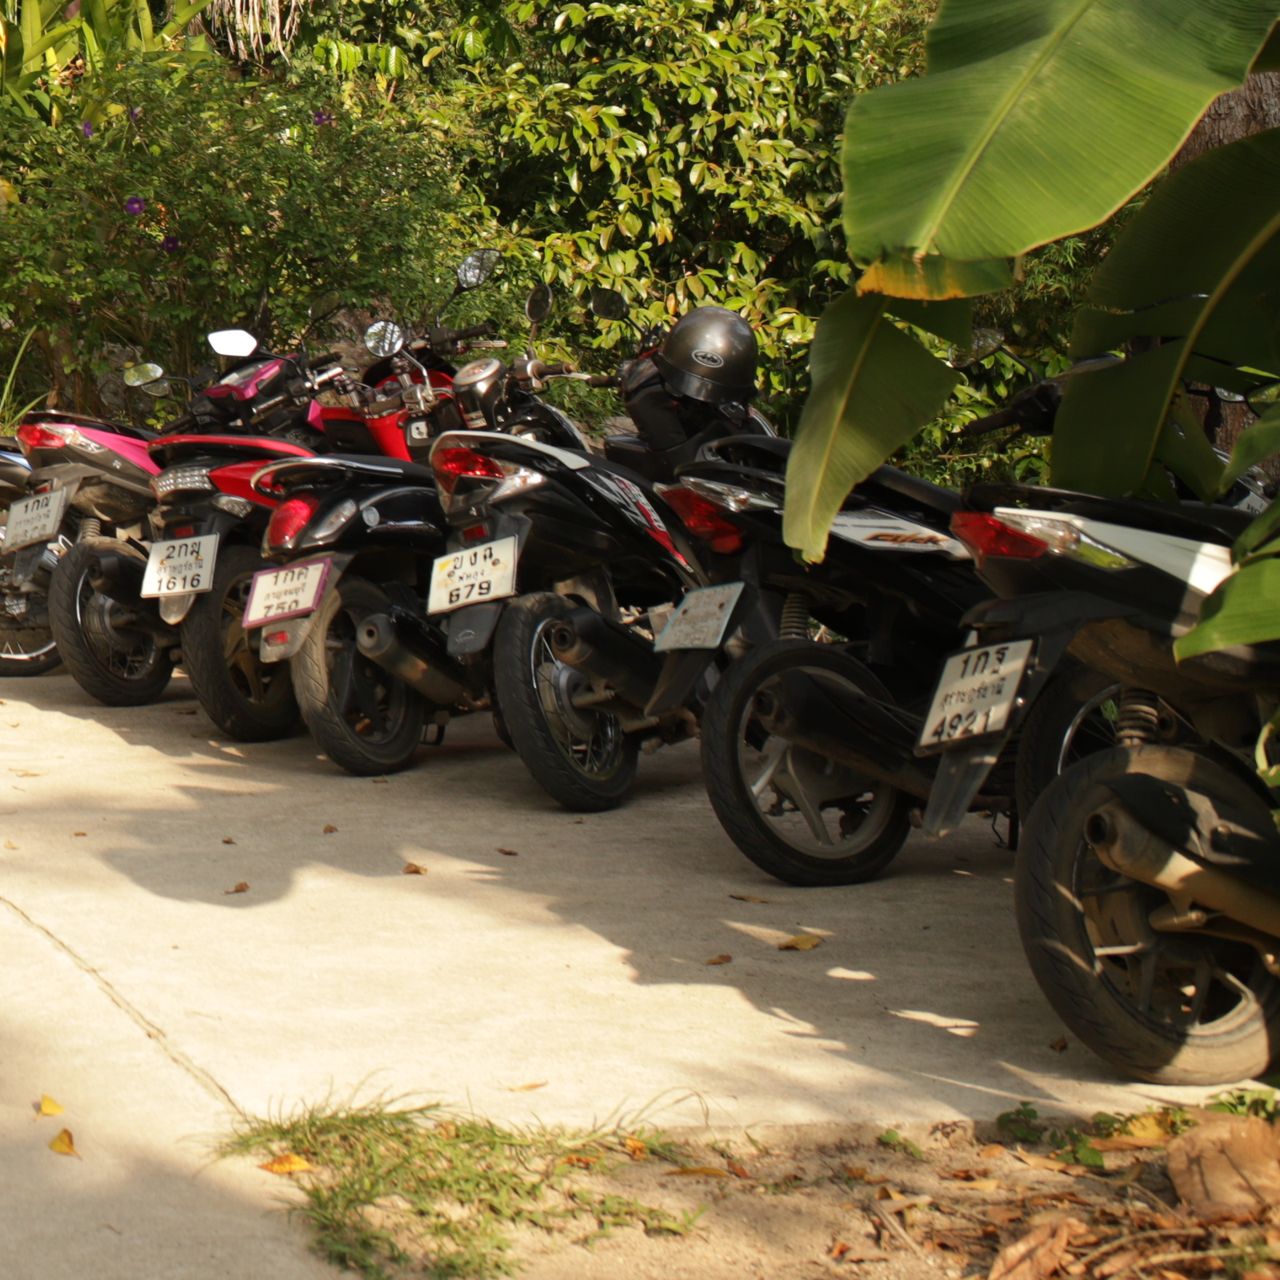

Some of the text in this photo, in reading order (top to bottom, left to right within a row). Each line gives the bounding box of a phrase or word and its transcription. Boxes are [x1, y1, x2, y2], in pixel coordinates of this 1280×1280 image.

[157, 573, 201, 592] 1616
[448, 579, 492, 604] 679
[931, 707, 992, 741] 4921
